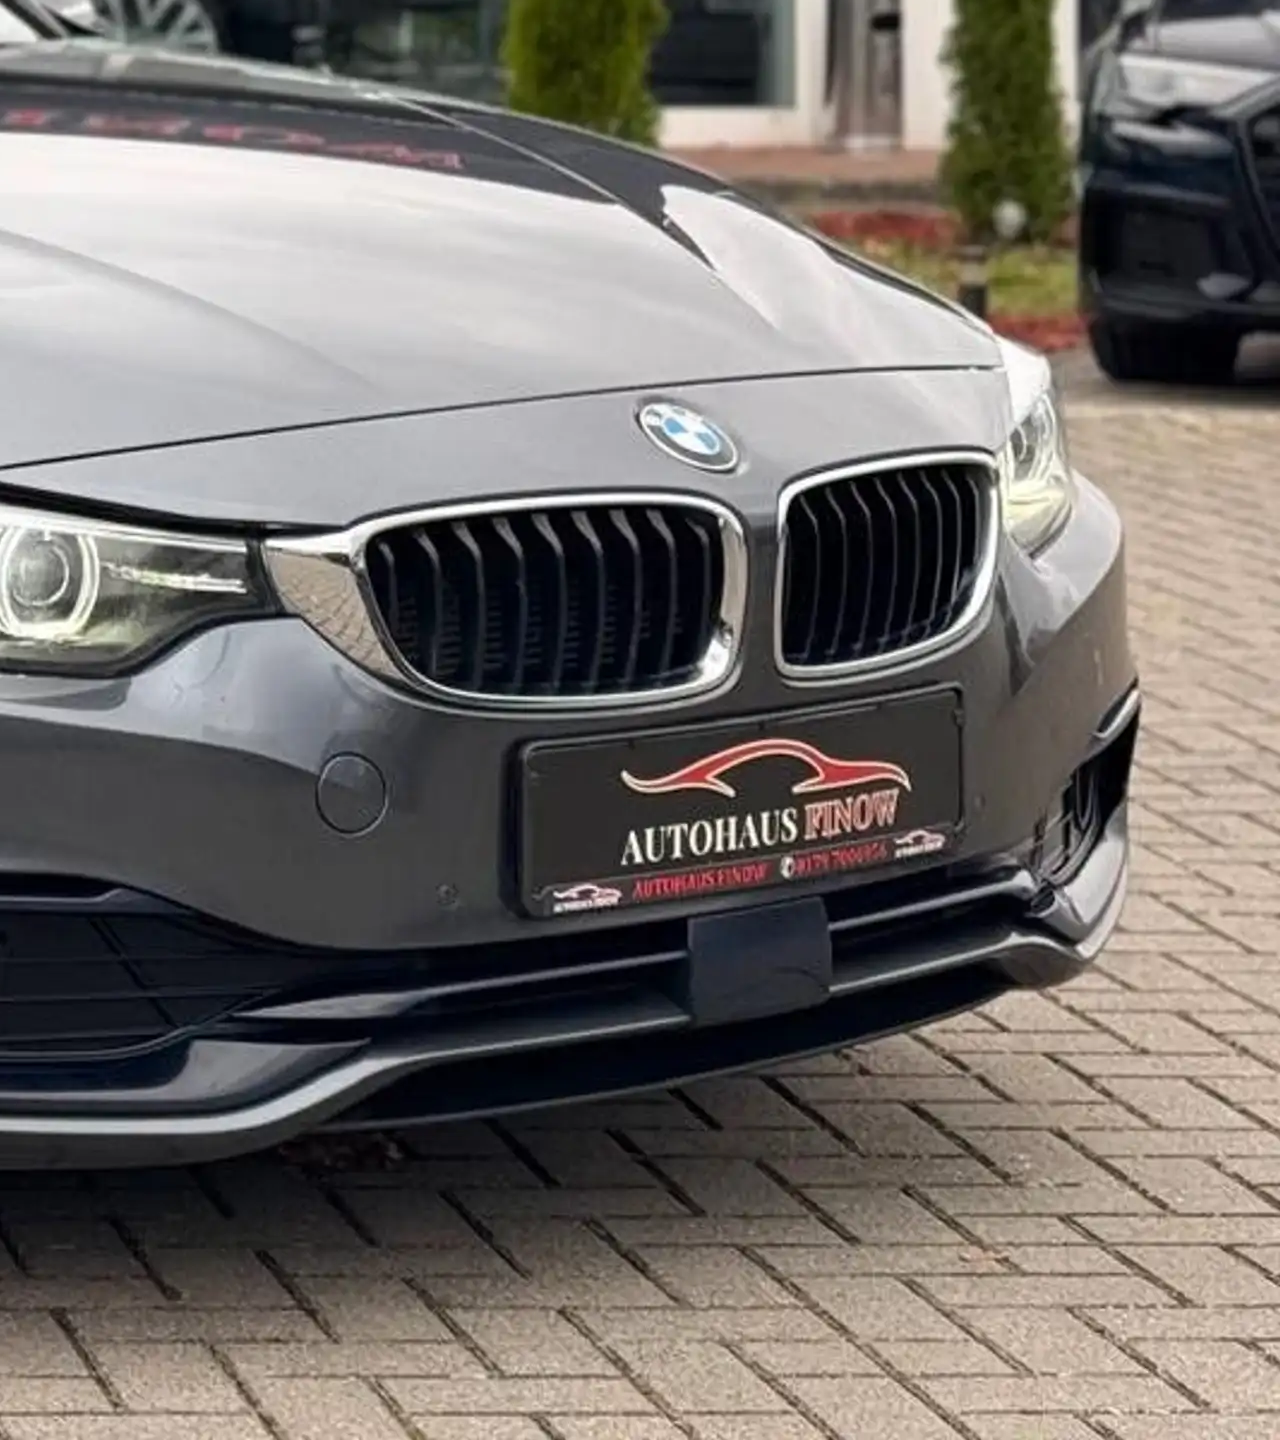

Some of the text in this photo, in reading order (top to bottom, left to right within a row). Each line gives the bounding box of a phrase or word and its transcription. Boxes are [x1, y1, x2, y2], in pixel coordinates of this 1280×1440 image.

[621, 810, 797, 865] AUTOHAUS
[804, 790, 898, 841] FINOW
[633, 868, 715, 898] AUTOHAUS
